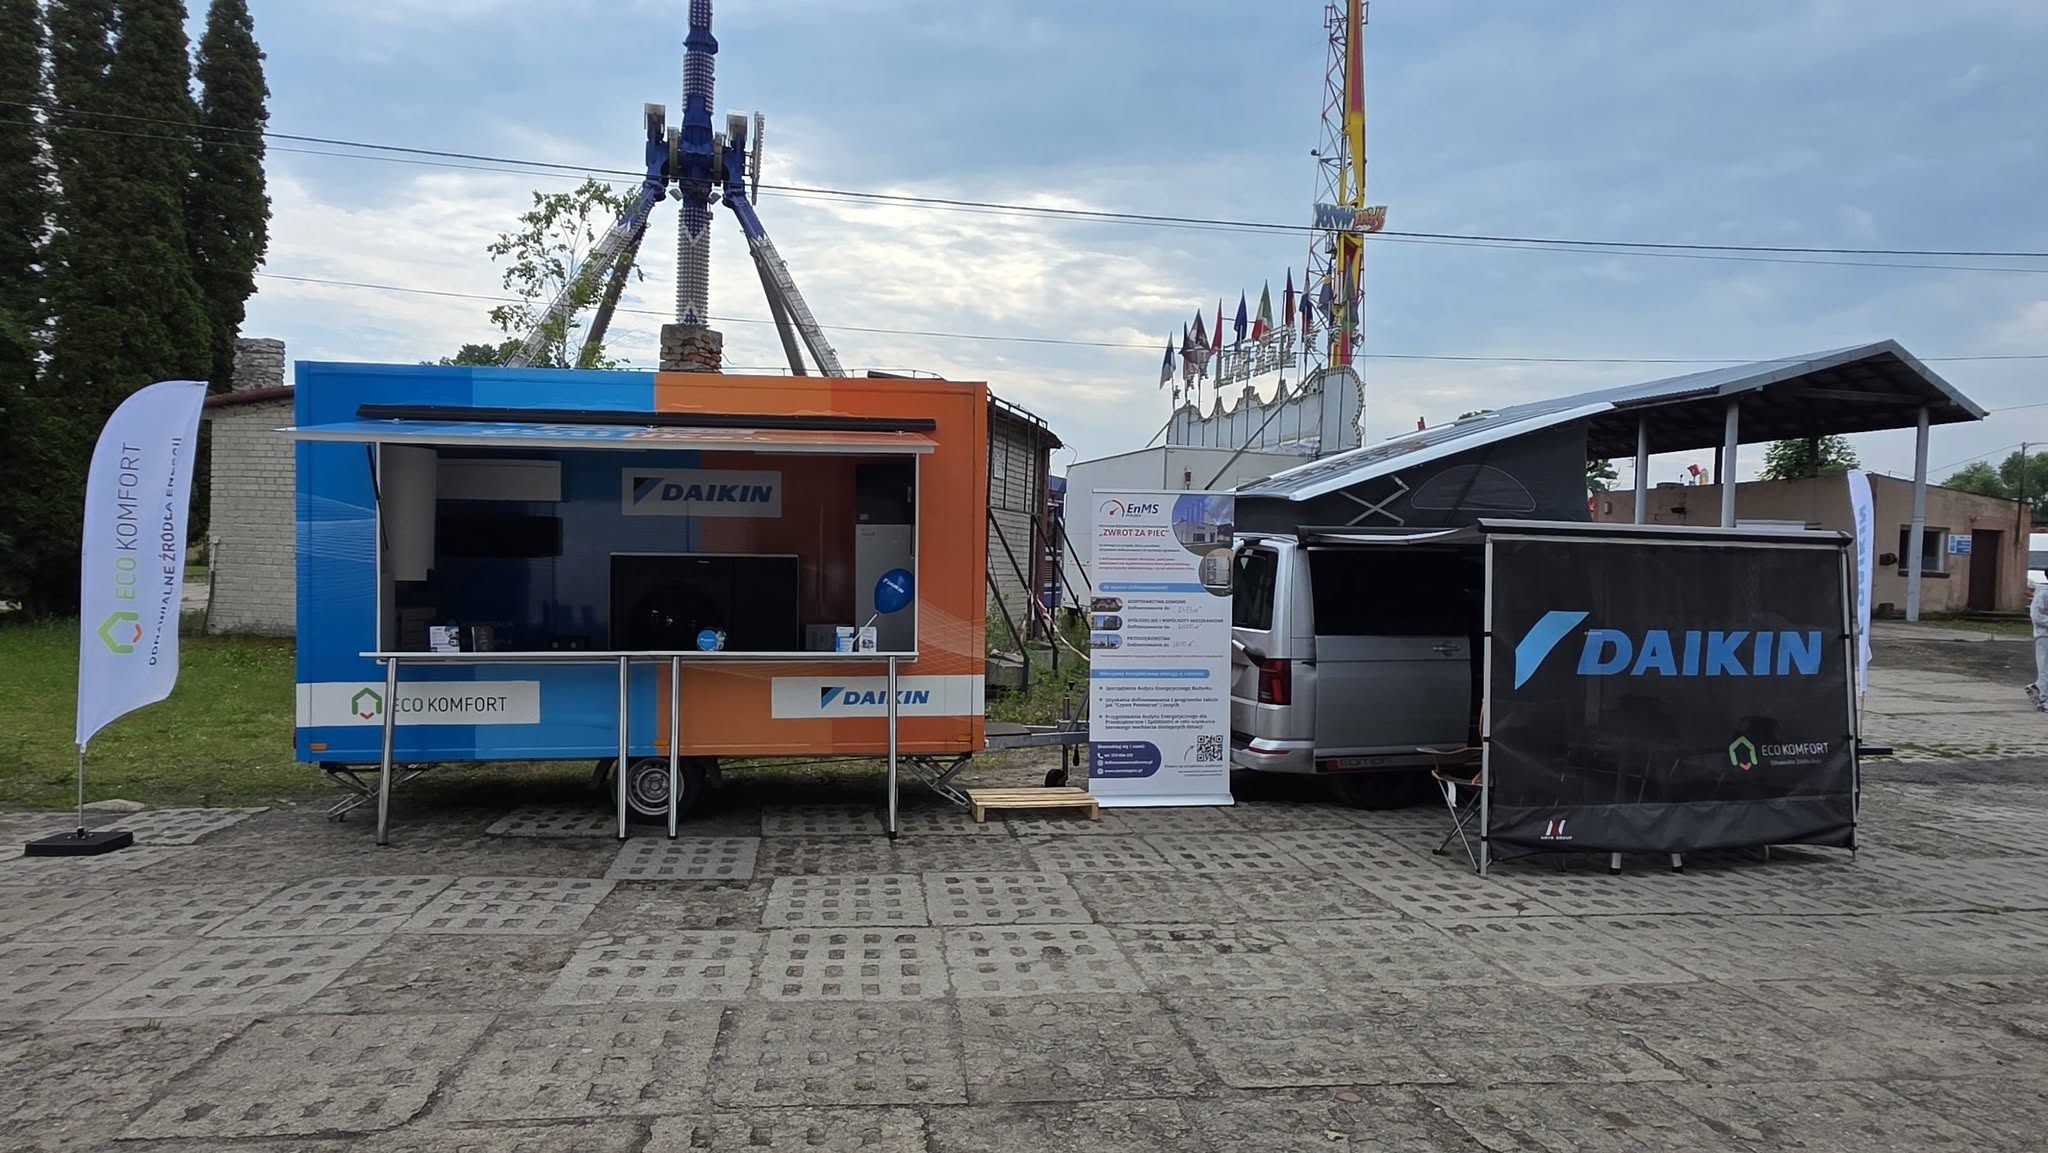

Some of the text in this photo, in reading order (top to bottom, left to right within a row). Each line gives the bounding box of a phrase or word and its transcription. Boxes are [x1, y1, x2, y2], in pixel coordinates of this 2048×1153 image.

[661, 484, 772, 502] DAIKIN
[1126, 504, 1160, 514] EnMS
[115, 442, 141, 600] ECO KOMFORT
[1576, 628, 1822, 676] DAIKIN
[428, 696, 508, 712] KOMFORT
[1761, 742, 1829, 756] ECO KOMFORT
